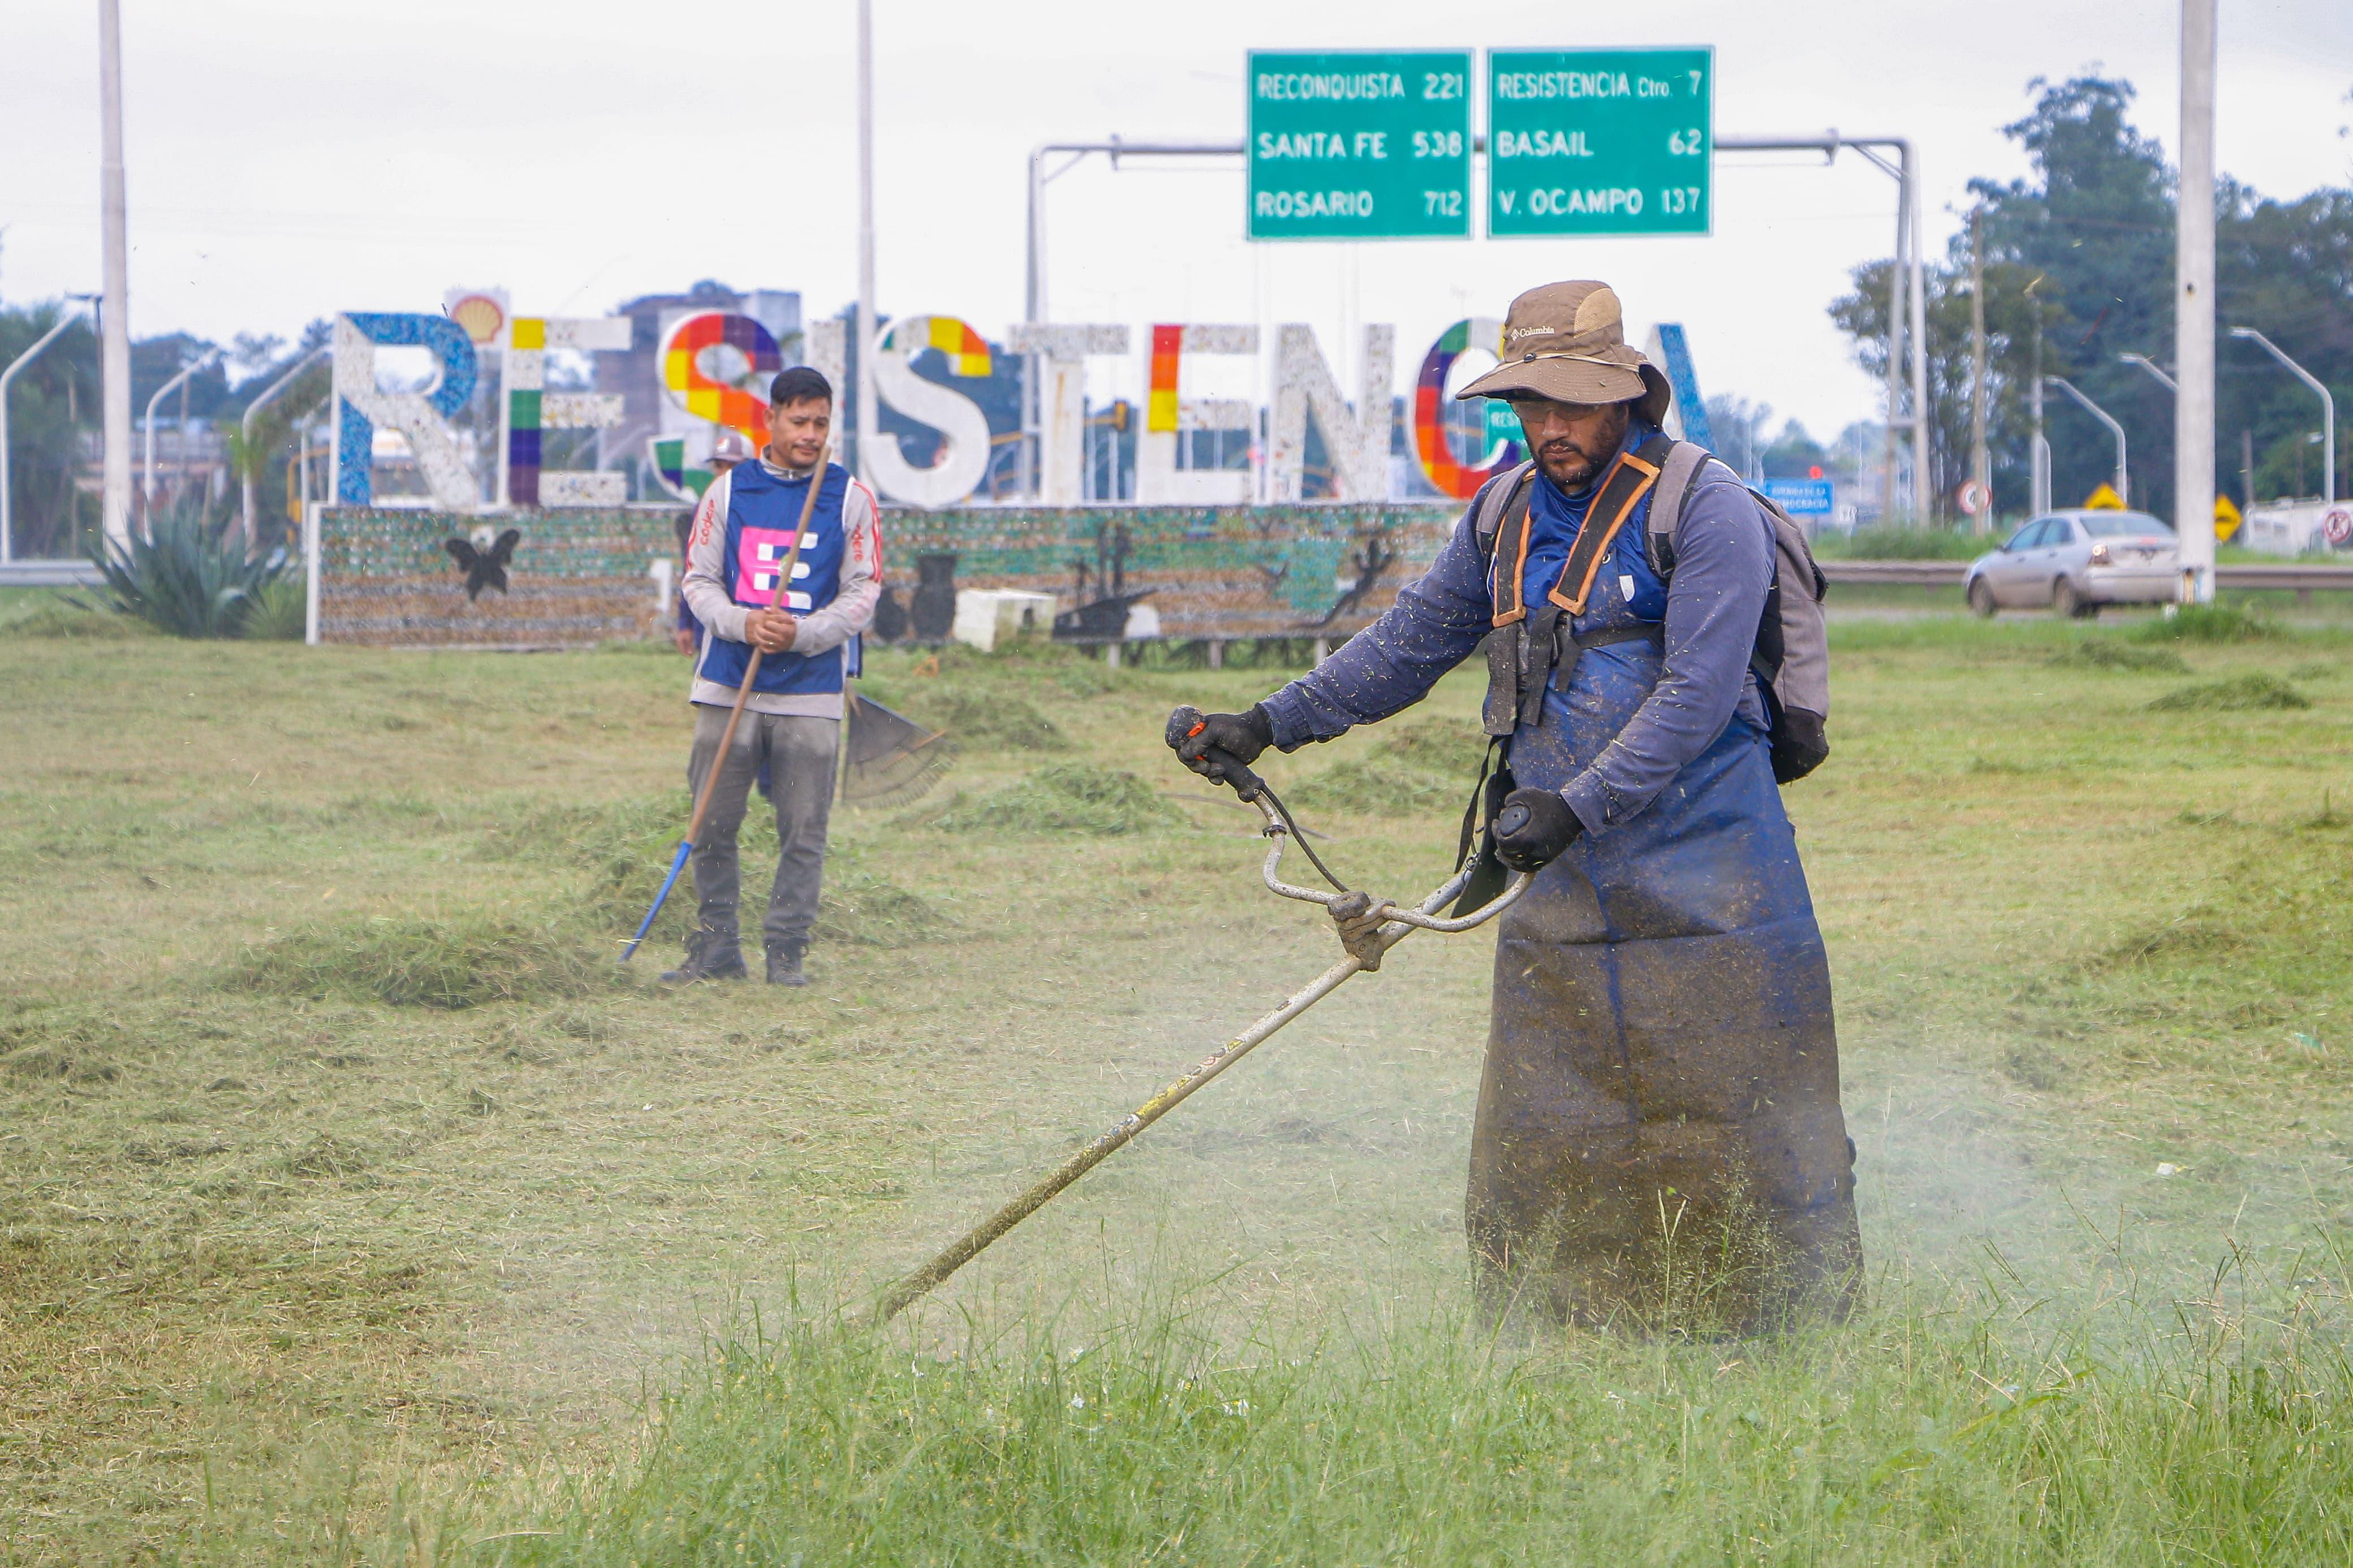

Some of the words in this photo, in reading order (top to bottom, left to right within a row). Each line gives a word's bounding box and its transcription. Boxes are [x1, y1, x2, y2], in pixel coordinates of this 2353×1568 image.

[1257, 71, 1406, 101] RECONQUISTA
[1423, 72, 1463, 100] 221
[1497, 71, 1631, 100] RESISTENCIA
[1688, 69, 1703, 96] 7
[1257, 131, 1347, 159] SANTA
[1354, 131, 1388, 159] FE
[1412, 130, 1463, 158] 538
[1496, 129, 1594, 158] BASAIL
[1668, 128, 1703, 155] 62
[1255, 189, 1374, 218] ROSARIO
[1423, 189, 1463, 217] 712
[1498, 189, 1523, 217] V.
[1528, 187, 1644, 216] OCAMPO
[1661, 187, 1701, 214] 137
[1519, 325, 1555, 338] Columbia
[331, 311, 1721, 509] RESISTENCA
